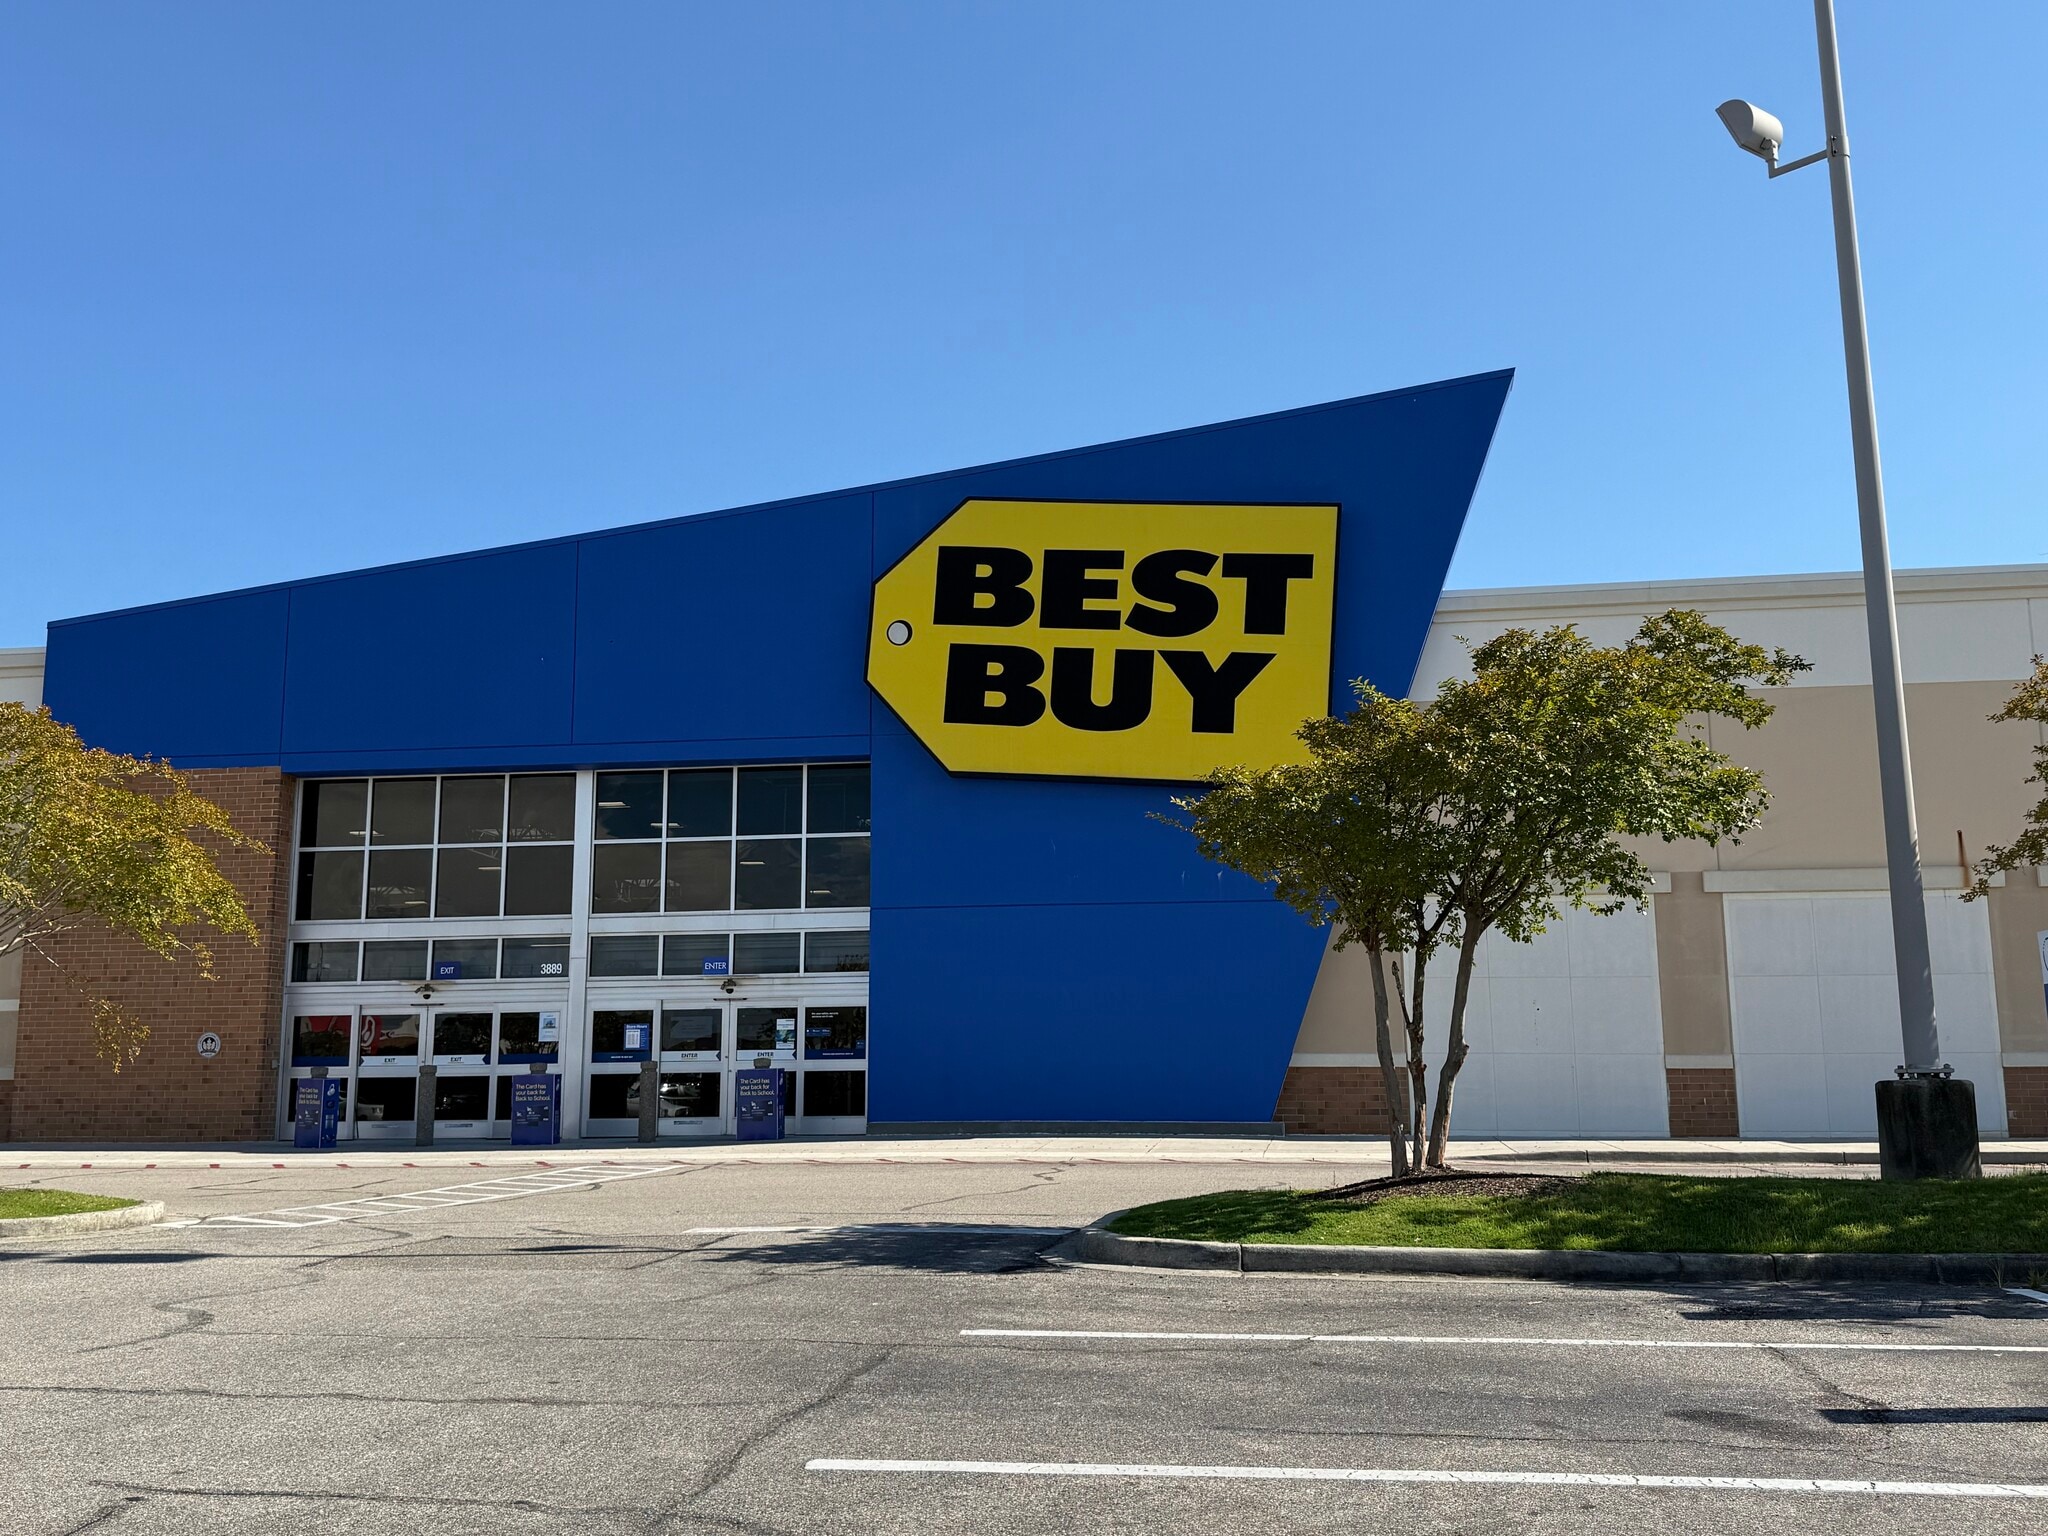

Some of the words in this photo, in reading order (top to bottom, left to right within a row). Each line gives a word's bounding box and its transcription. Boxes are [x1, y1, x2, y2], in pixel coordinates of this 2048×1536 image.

[933, 545, 1315, 638] BEST
[943, 643, 1278, 734] BUY
[440, 966, 455, 975] EXIT
[540, 963, 563, 975] 3889
[704, 961, 727, 970] ENTER
